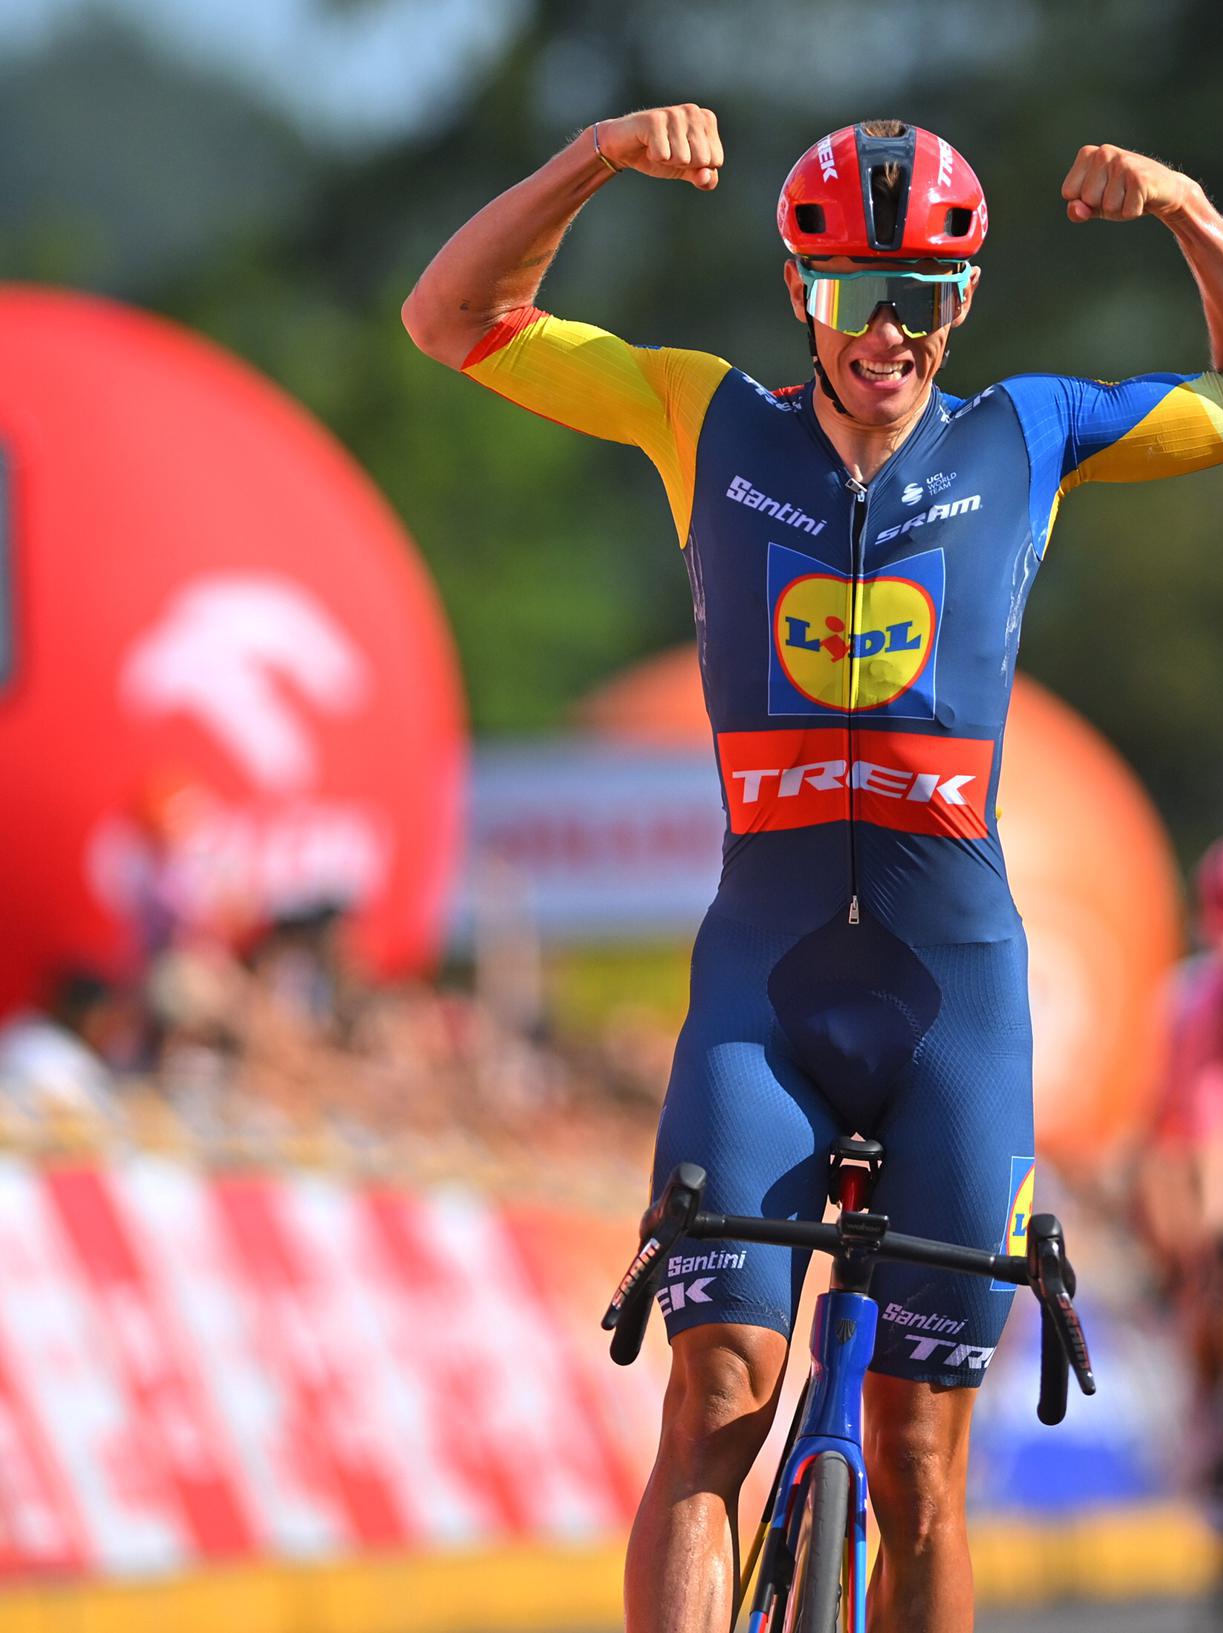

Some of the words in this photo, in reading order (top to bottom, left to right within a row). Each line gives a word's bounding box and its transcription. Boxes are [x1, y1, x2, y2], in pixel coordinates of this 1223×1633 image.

[936, 136, 955, 188] TRE
[926, 472, 943, 485] UCI
[927, 471, 958, 490] WORLD
[928, 481, 952, 496] TEAM
[726, 474, 827, 537] Santini
[732, 759, 976, 806] TREK
[667, 1249, 747, 1278] Santini
[655, 1276, 718, 1319] EK
[881, 1302, 969, 1335] Santini
[904, 1333, 998, 1370] TR
